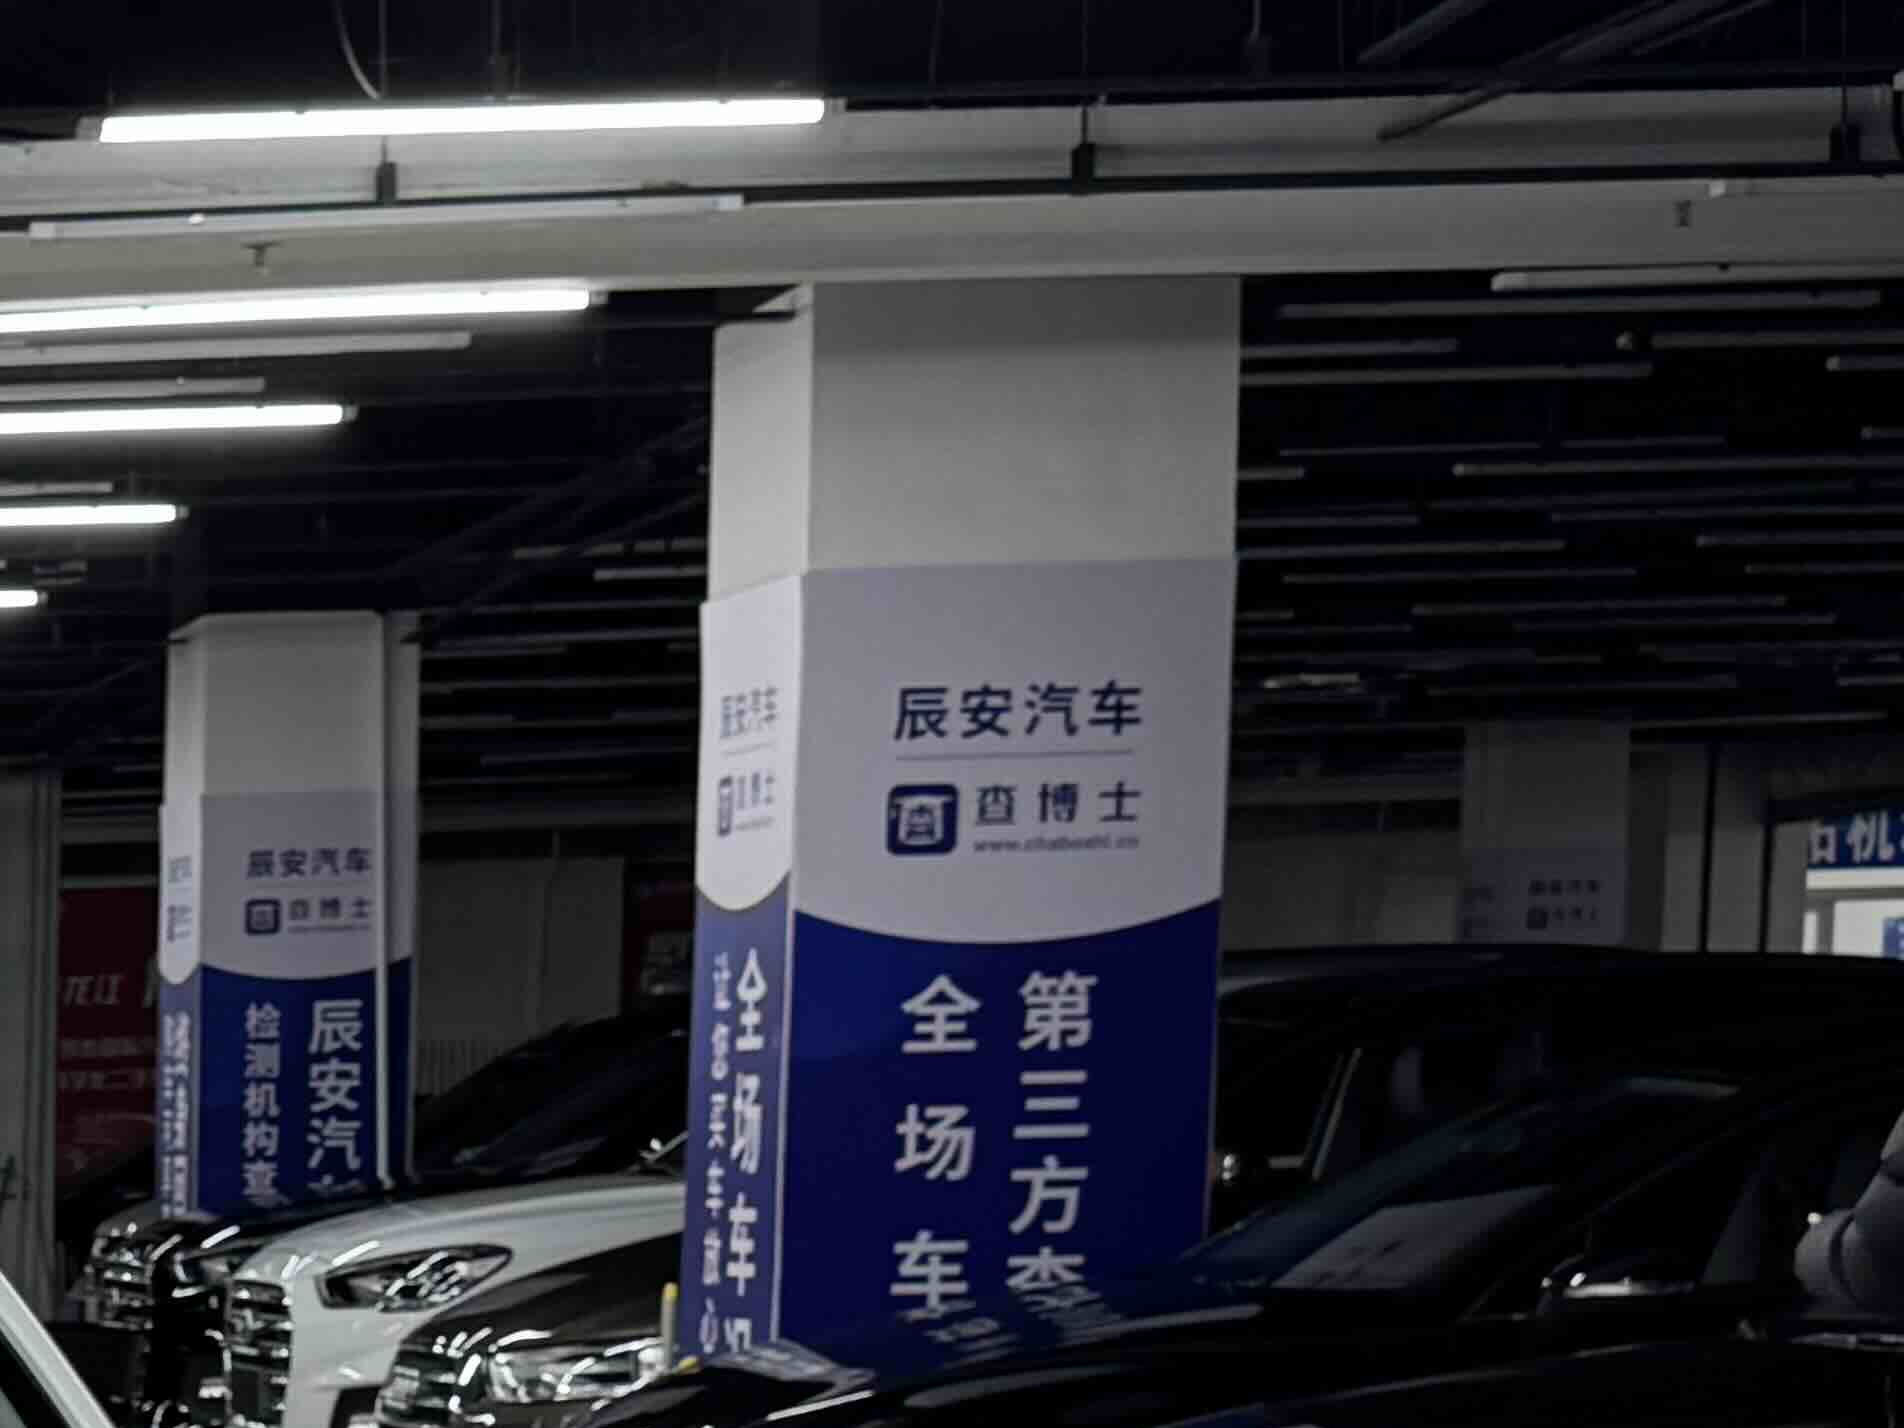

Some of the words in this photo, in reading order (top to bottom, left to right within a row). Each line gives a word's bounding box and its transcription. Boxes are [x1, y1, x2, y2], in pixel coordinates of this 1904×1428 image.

[894, 679, 1143, 741] 辰安汽车
[306, 998, 363, 1188] 辰安汽
